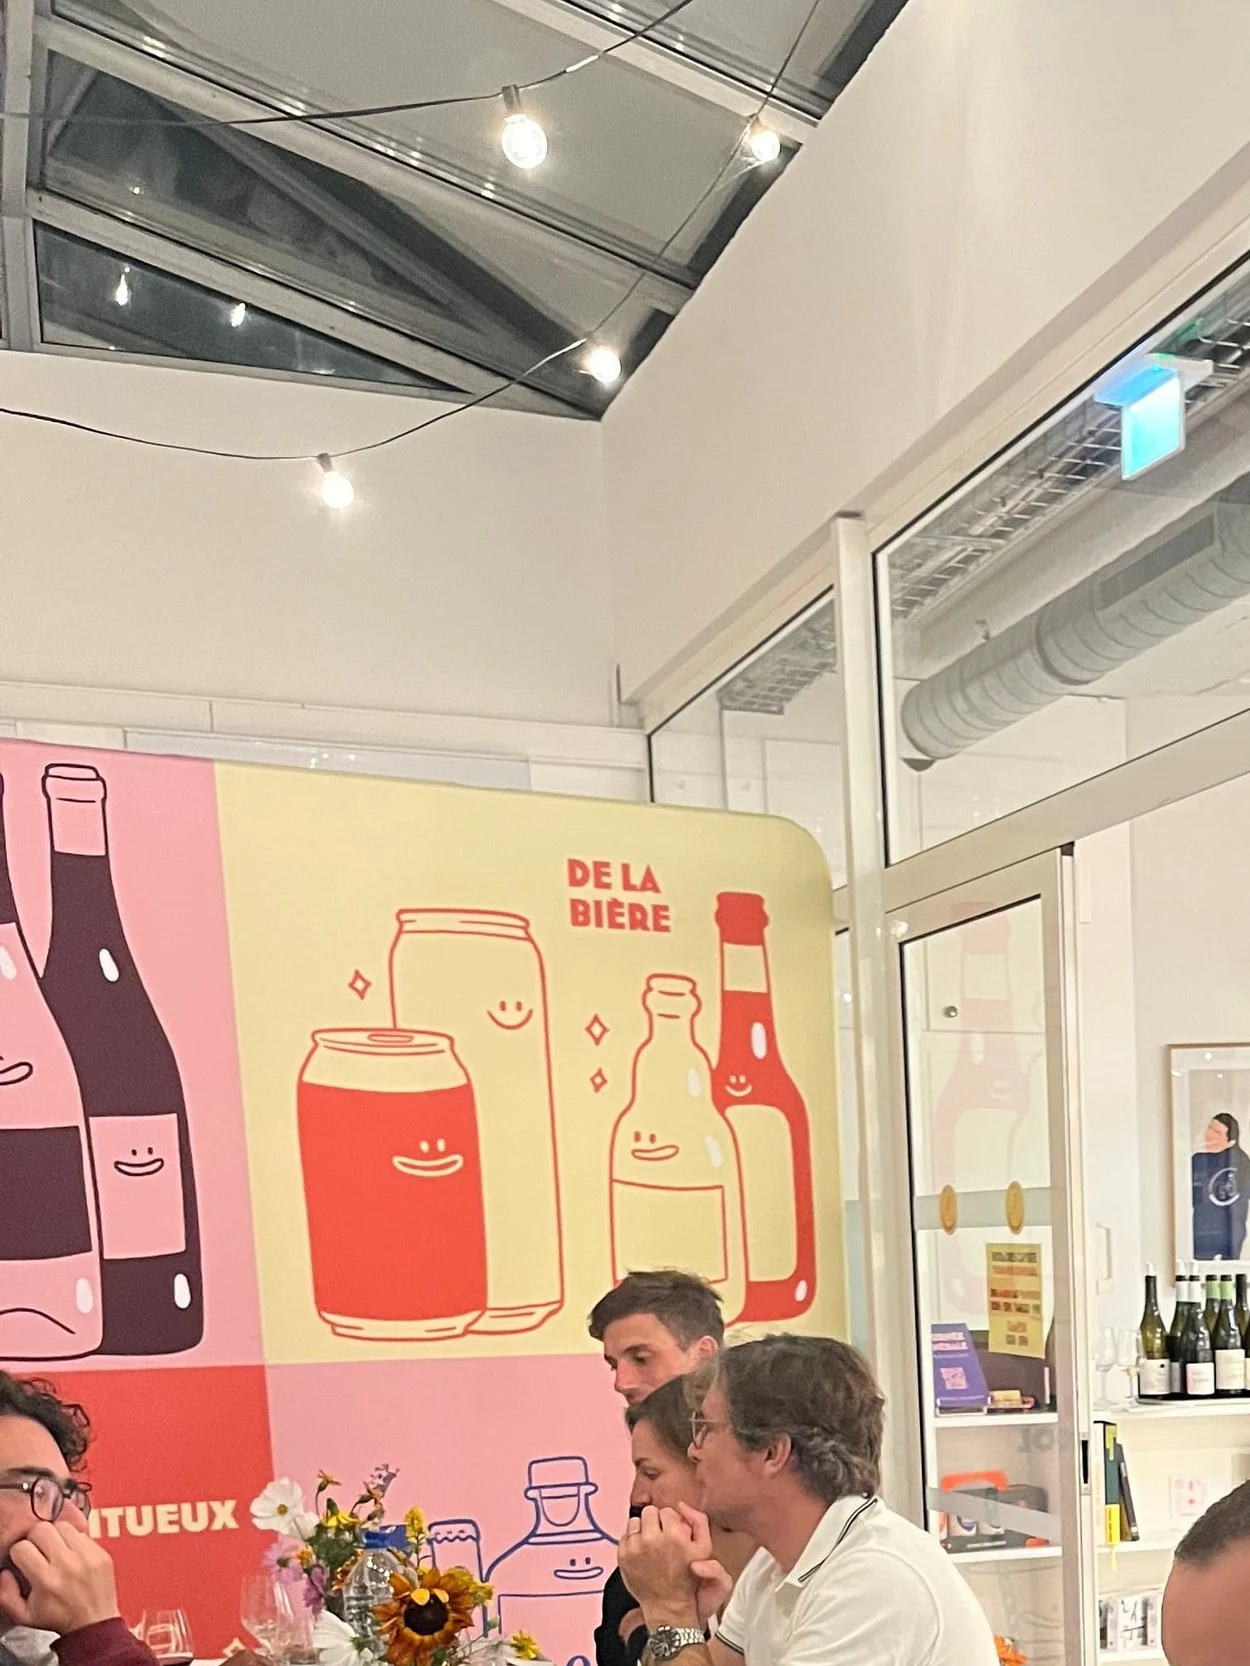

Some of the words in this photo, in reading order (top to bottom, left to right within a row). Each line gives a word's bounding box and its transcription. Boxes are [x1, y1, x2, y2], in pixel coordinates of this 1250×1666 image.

[567, 858, 612, 890] DE
[621, 863, 661, 894] LA
[569, 897, 672, 933] BIÈRE
[87, 1499, 240, 1540] ITUEUX
